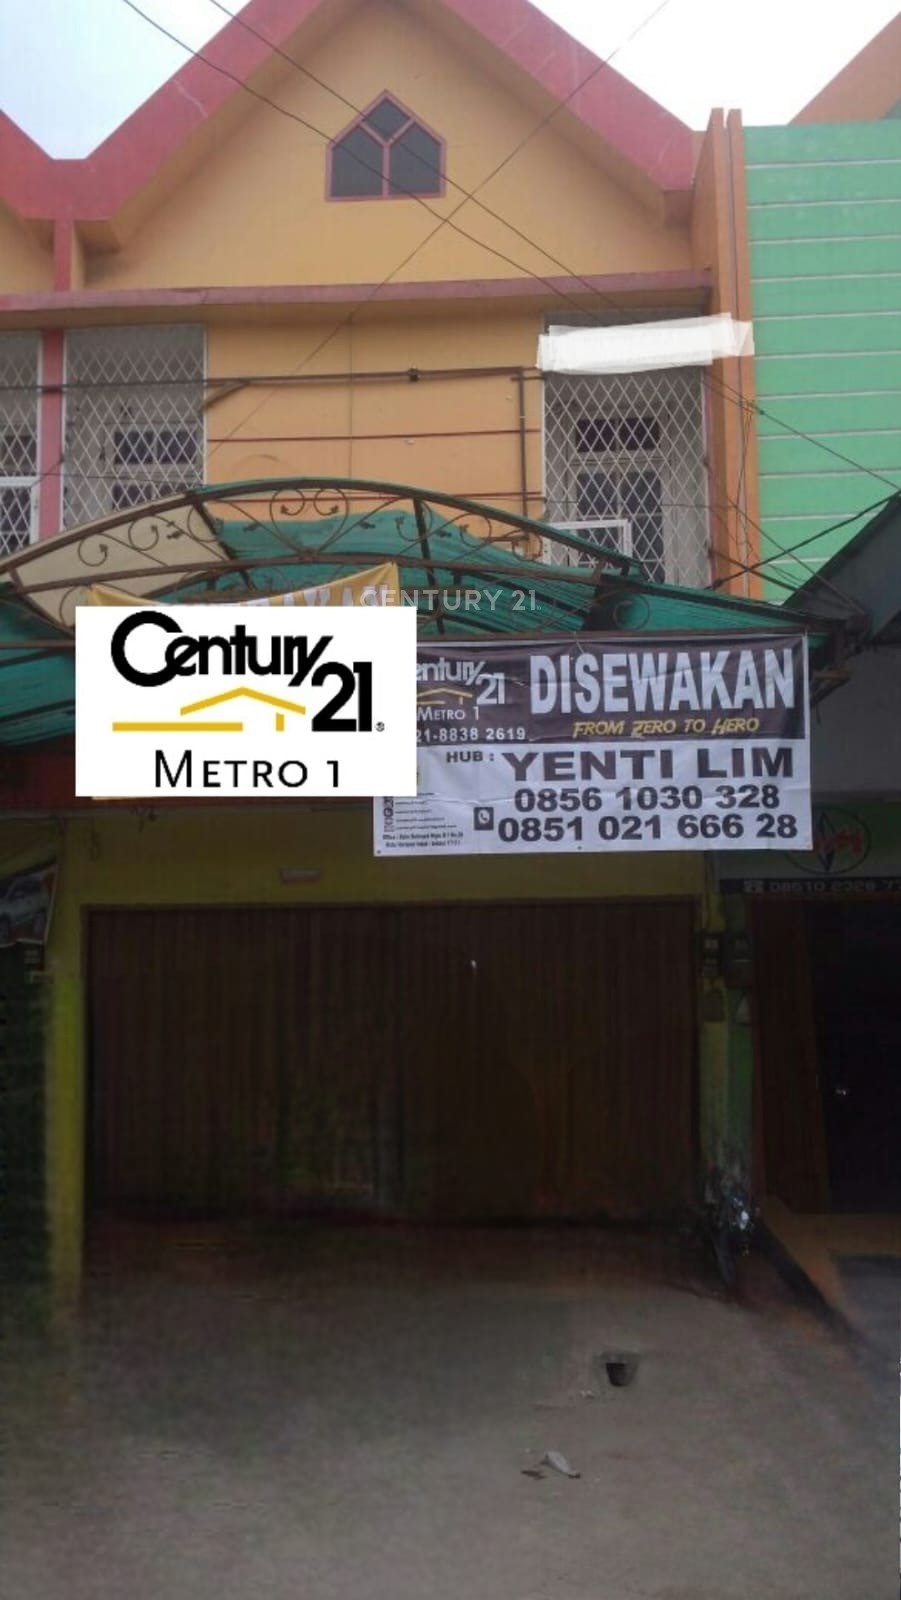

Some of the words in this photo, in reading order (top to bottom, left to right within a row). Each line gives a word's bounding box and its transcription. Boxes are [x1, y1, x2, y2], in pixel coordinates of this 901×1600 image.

[416, 657, 485, 686] entury
[476, 672, 506, 705] 21
[530, 648, 795, 714] DISEWAKAN
[473, 706, 480, 720] 1
[416, 727, 479, 742] 21-8838
[486, 726, 526, 741] 2619
[572, 720, 625, 739] FROM
[631, 719, 677, 739] ZERO
[684, 718, 707, 734] TO
[711, 717, 760, 736] HERO
[446, 751, 483, 763] HUB
[501, 750, 673, 782] YENTI
[697, 747, 793, 778] LIM
[514, 787, 602, 813] 0856
[616, 785, 702, 811] 1030
[714, 784, 780, 809] 328
[498, 816, 583, 842] 0851
[598, 814, 661, 841] 021
[677, 813, 744, 840] 666
[755, 813, 798, 839] 28
